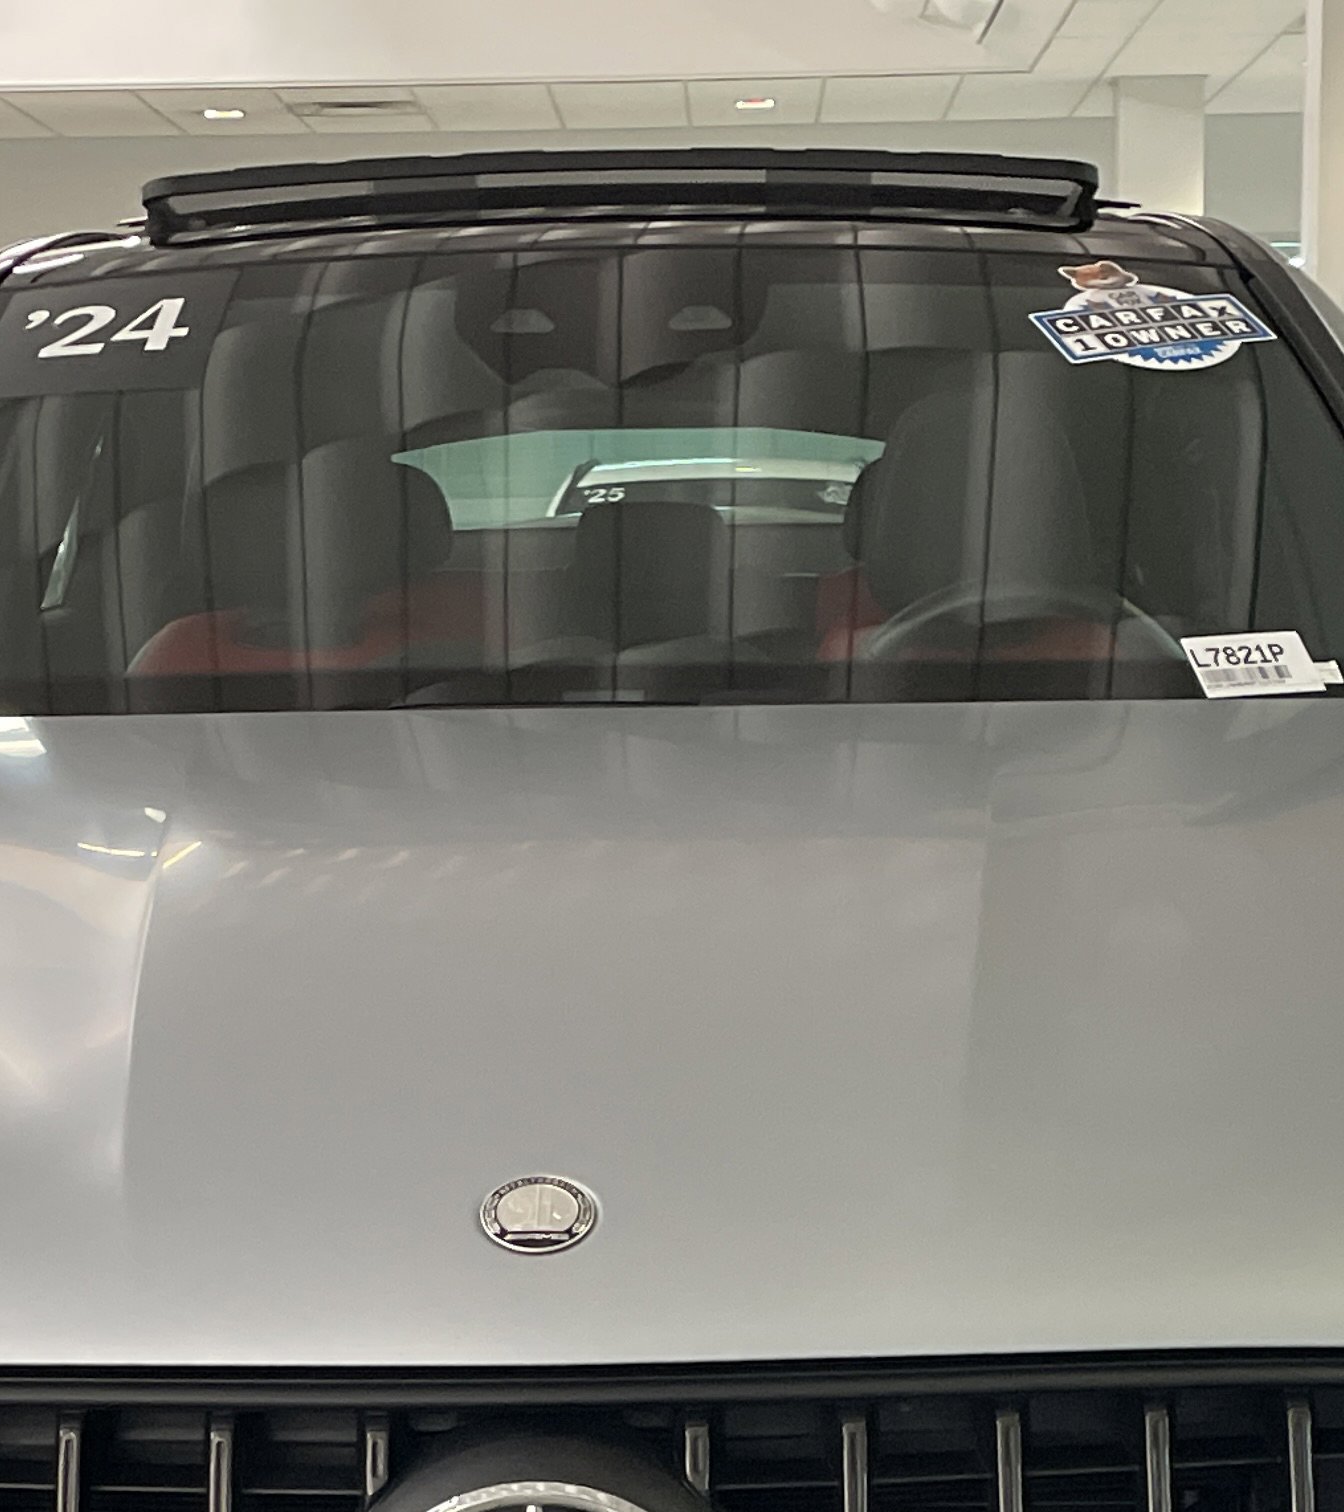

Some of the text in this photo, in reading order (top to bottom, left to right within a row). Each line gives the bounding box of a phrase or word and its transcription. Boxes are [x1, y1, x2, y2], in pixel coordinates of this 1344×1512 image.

[24, 297, 190, 359] '24
[1055, 302, 1237, 333] CARFAX
[1073, 319, 1251, 353] 1 OWNER
[1189, 643, 1285, 668] L7821P
